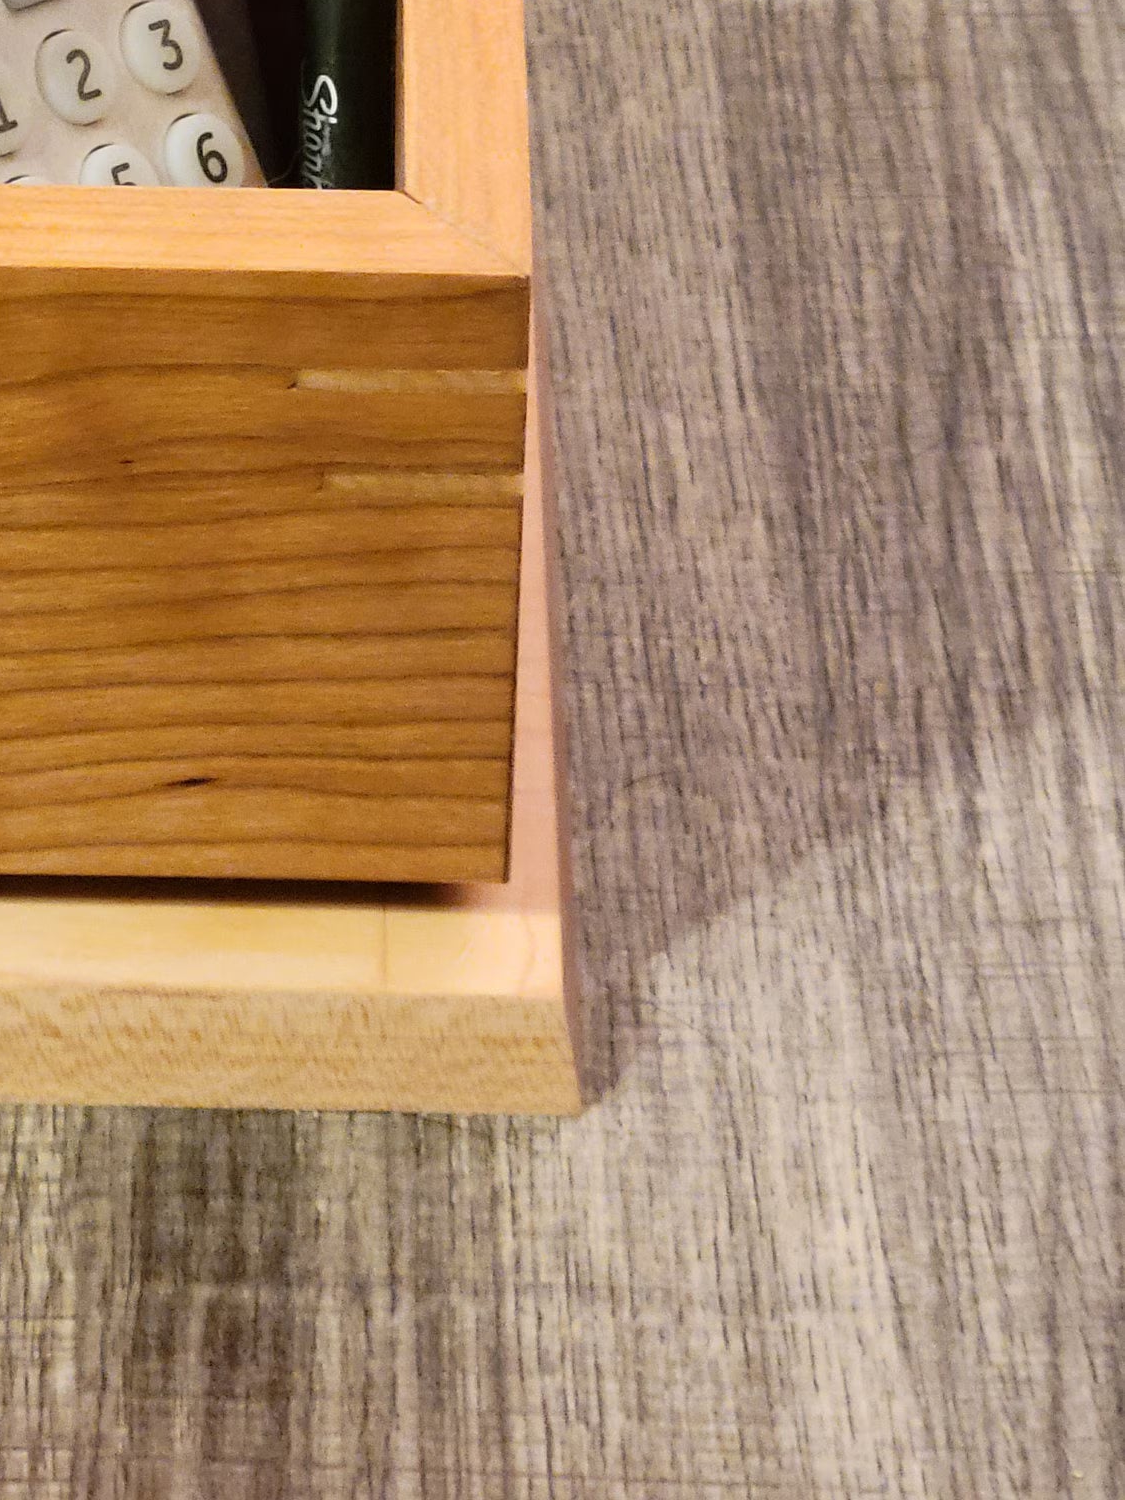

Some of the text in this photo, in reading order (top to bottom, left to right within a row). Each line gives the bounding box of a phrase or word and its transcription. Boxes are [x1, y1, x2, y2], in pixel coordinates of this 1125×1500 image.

[148, 19, 184, 71] 3
[66, 49, 102, 101] 2
[196, 131, 228, 184] 6
